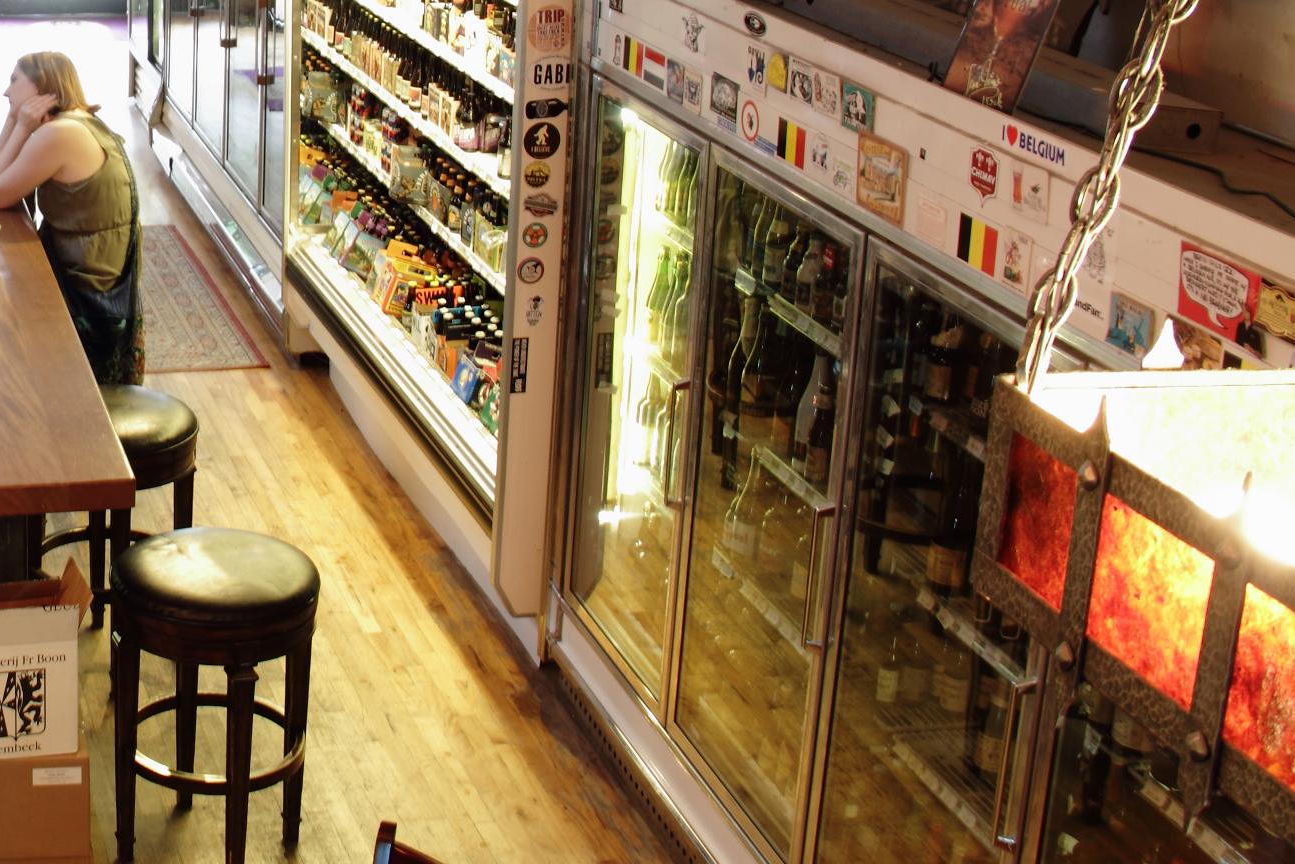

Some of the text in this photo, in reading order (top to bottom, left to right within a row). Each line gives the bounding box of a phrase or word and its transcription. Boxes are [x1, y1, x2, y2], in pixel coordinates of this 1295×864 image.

[537, 9, 565, 24] TRIP
[1001, 124, 1065, 166] I BELGIUM
[971, 166, 996, 185] CHIMAY
[22, 655, 34, 666] Fr
[37, 653, 66, 664] Boon
